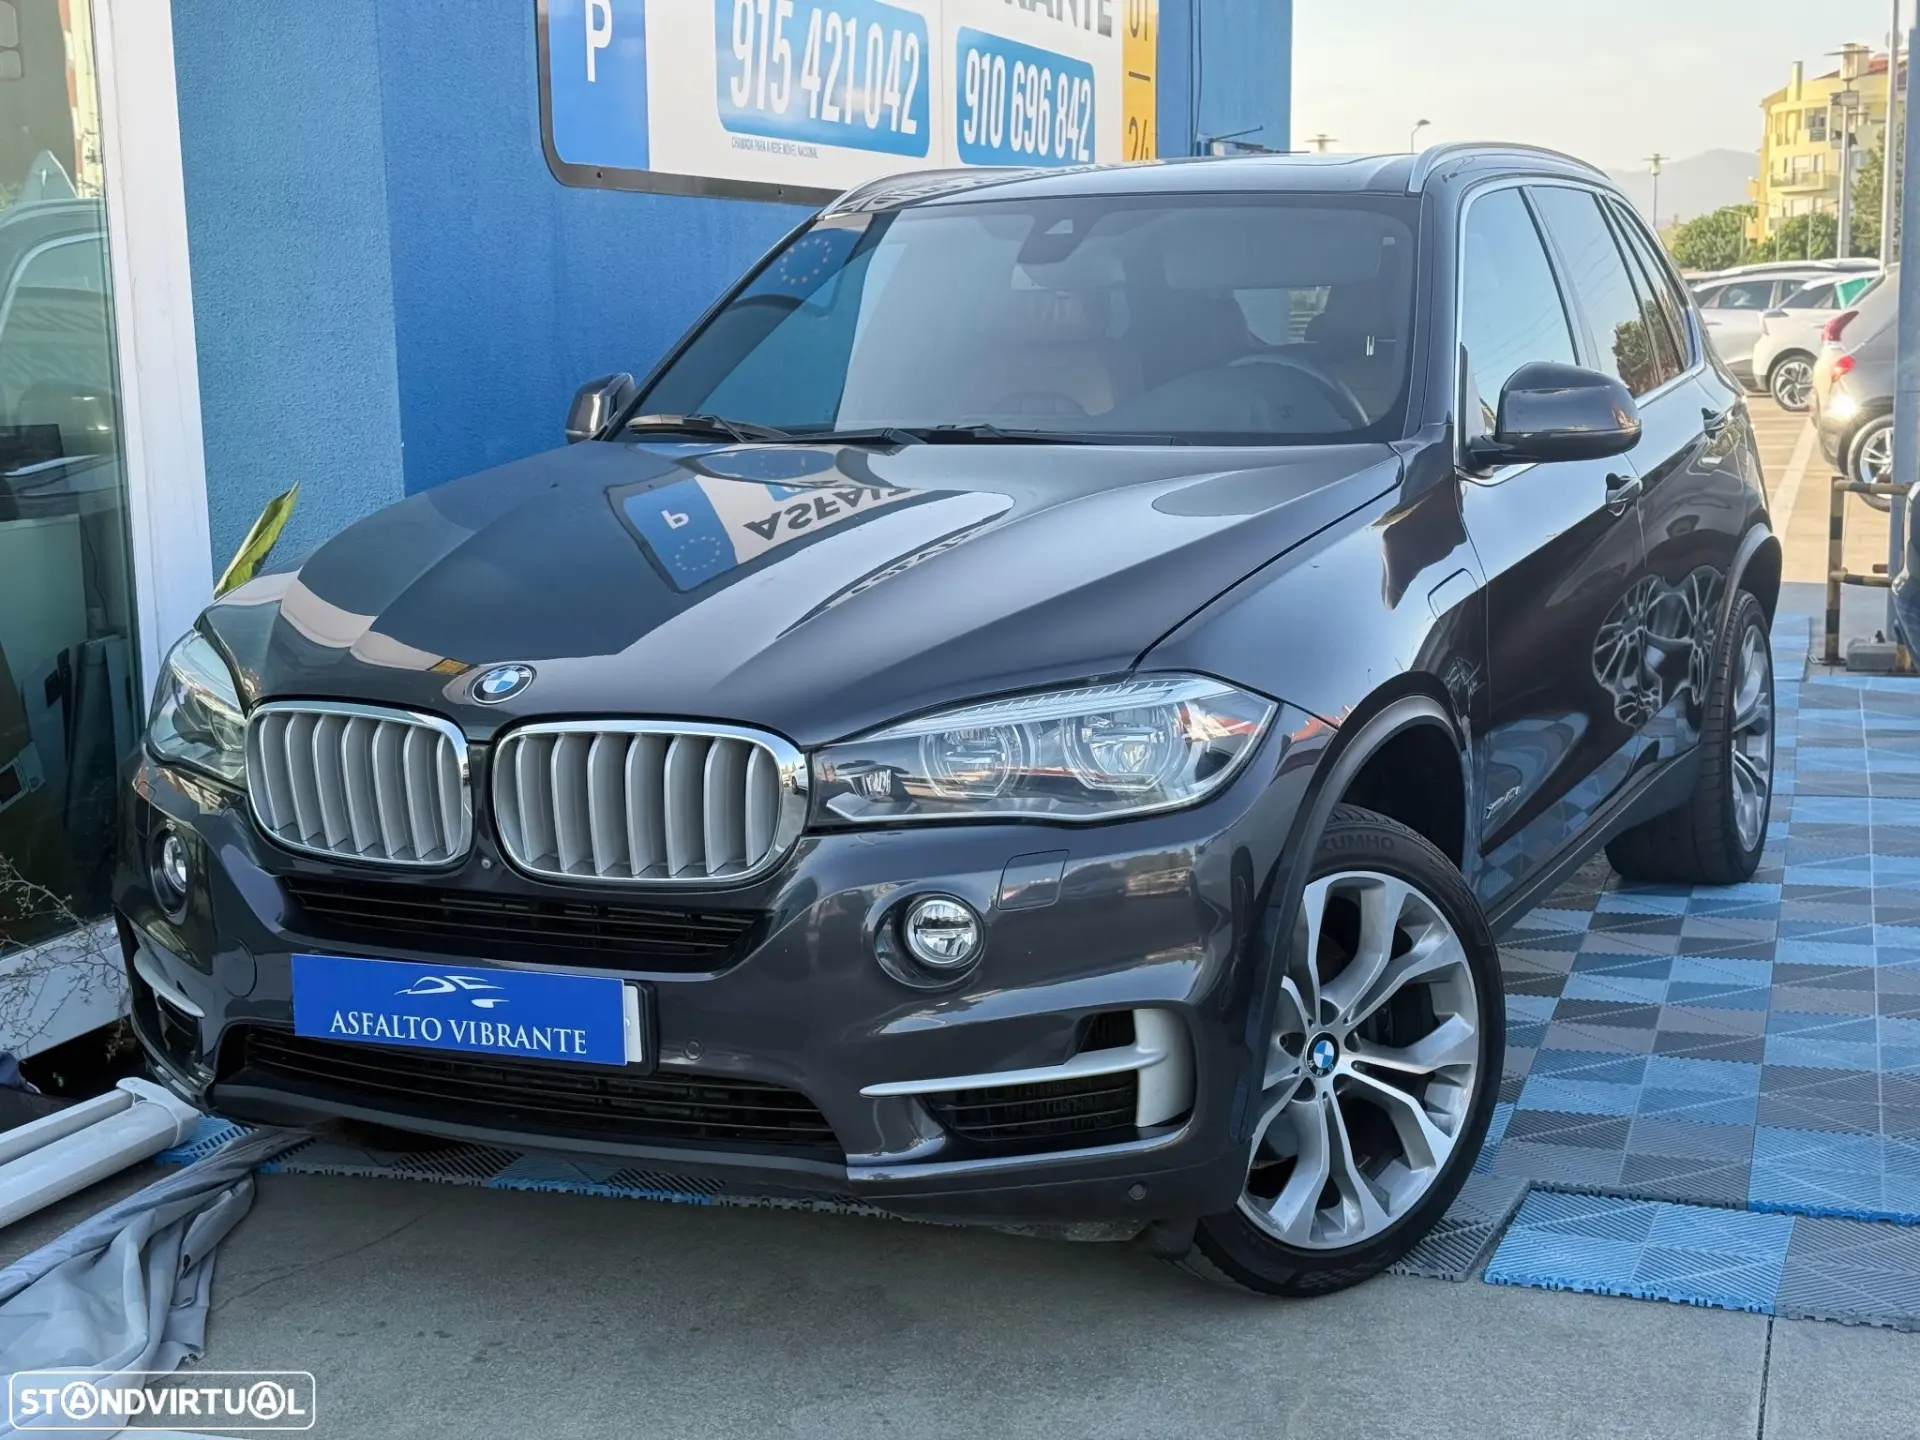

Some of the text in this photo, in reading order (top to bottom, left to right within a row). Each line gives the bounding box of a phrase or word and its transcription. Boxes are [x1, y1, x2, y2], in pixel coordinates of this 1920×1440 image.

[585, 0, 612, 83] P
[731, 0, 919, 135] 915 421 042
[964, 48, 1091, 162] 910 696 842
[330, 1010, 587, 1055] ASFALTO VIBRANTE
